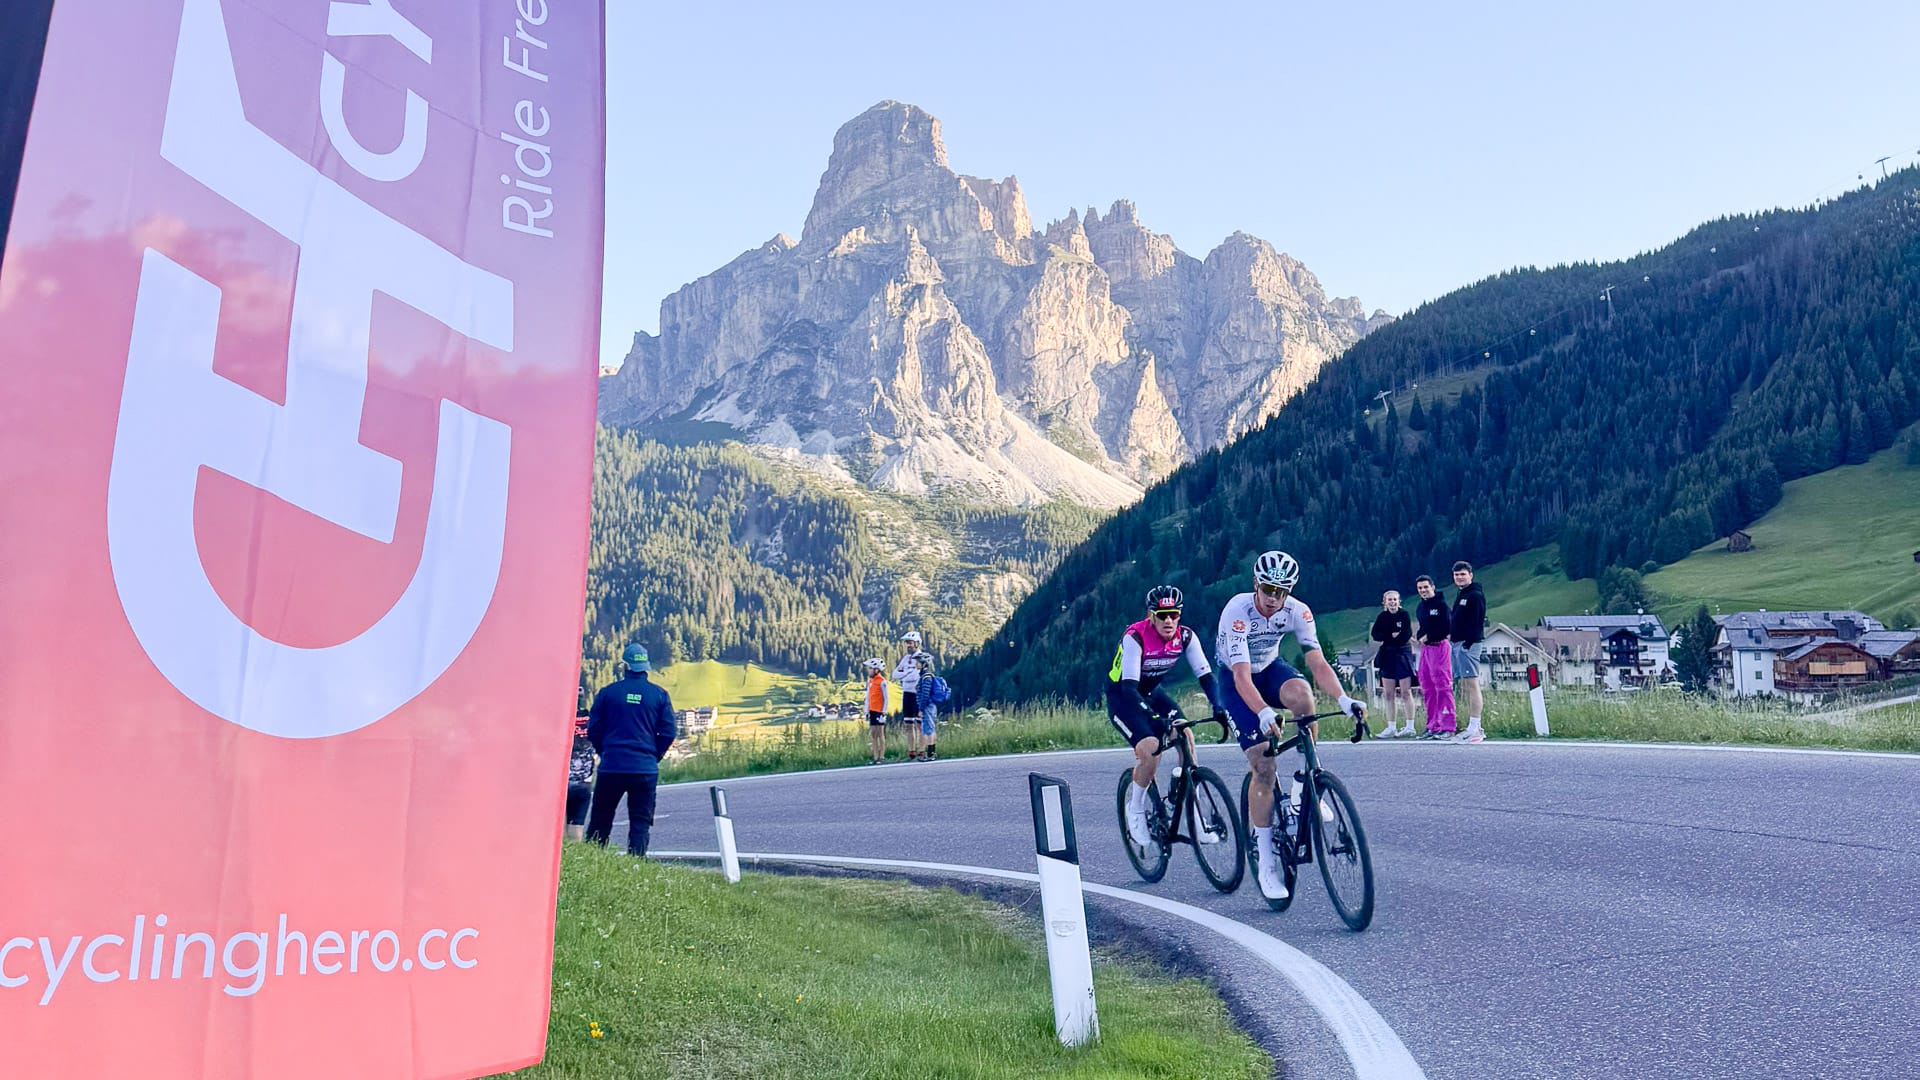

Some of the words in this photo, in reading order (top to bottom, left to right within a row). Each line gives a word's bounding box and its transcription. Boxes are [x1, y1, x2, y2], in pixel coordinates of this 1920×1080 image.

[502, 0, 549, 83] Fre
[500, 99, 554, 238] Ride
[0, 913, 480, 1006] cyclinghero.cc
